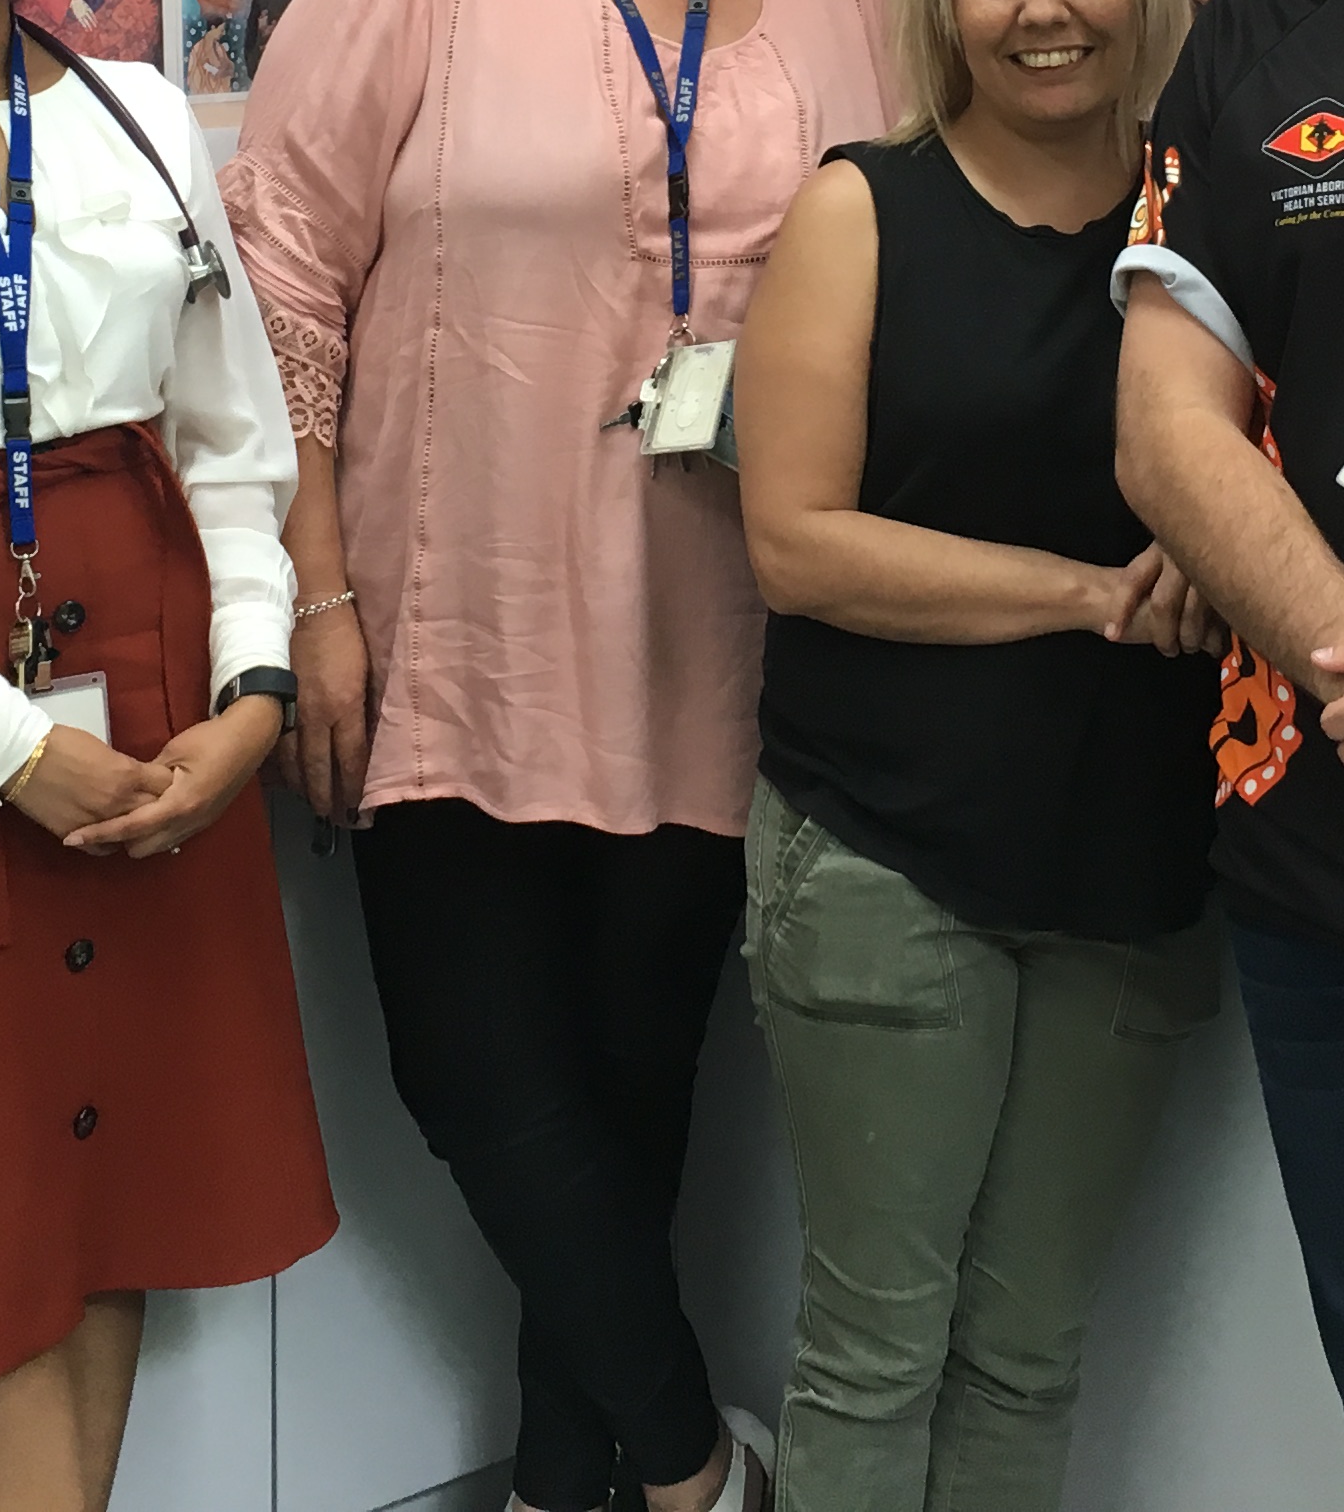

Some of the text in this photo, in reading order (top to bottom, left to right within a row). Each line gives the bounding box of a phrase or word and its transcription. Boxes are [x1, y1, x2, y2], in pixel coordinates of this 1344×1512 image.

[14, 74, 28, 117] STAFF
[676, 77, 694, 123] STAFF
[1271, 183, 1313, 201] VICTORIAN
[1283, 197, 1315, 212] HEALTH
[1296, 213, 1307, 224] for
[1309, 211, 1322, 220] the
[674, 230, 684, 281] STAFF
[12, 450, 29, 509] STAFF
